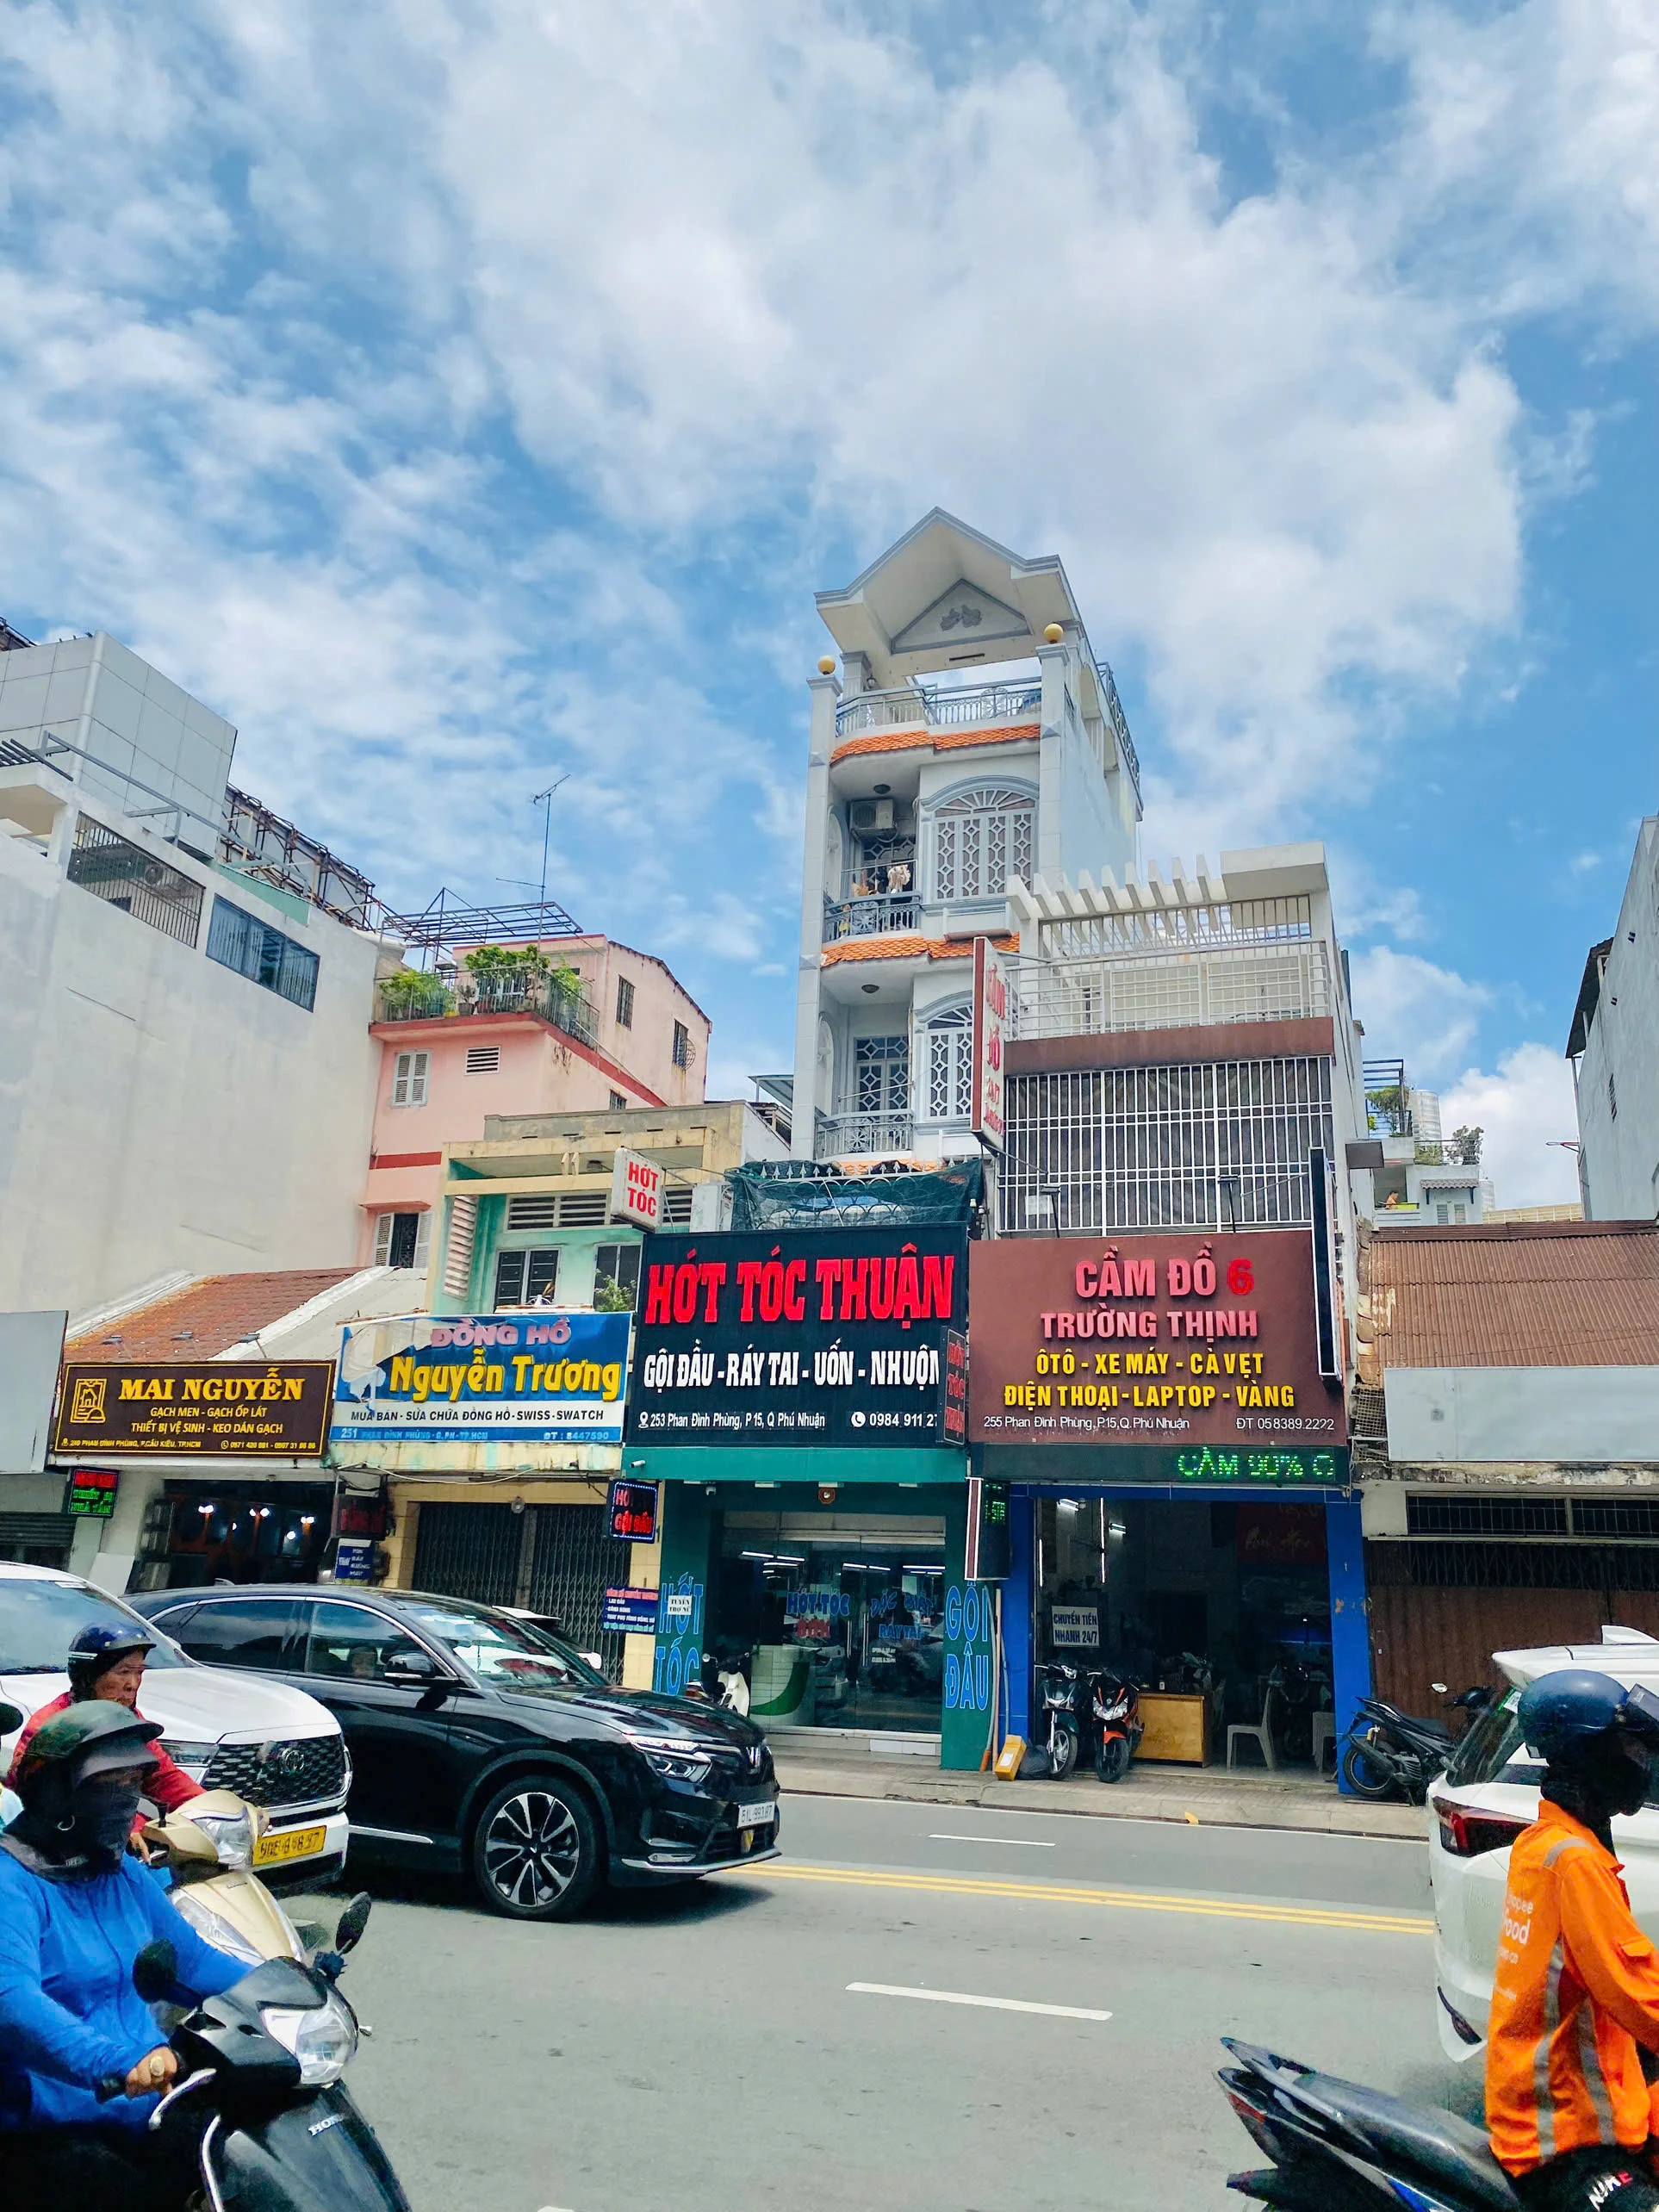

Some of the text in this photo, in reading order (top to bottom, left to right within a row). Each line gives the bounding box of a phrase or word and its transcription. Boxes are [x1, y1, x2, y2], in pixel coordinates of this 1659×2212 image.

[628, 1161, 658, 1192] HỚT
[627, 1186, 656, 1216] TÓC
[1075, 1241, 1254, 1297] CẦM ĐỒ 6
[644, 1242, 954, 1329] HỚT TÓC THUẬN
[430, 1316, 572, 1348] ĐỒNG HỒ
[1041, 1302, 1258, 1343] TRƯỜNG THỊNH
[389, 1347, 622, 1403] Nguyễn Trương
[643, 1347, 675, 1393] GỘI
[676, 1339, 714, 1388] ĐẦU
[727, 1343, 764, 1387] RÁY
[768, 1351, 799, 1386] TAI
[813, 1337, 854, 1386] UỐN
[1036, 1346, 1264, 1378] ÔTÔ XE MÁY CÀ VẸT
[118, 1367, 306, 1401] MAI NGUYỄN
[1004, 1380, 1295, 1411] ĐIỆN THOẠI LAPTOP VÀNG
[150, 1404, 268, 1420] GẠCH MEN GẠCH ỐP LÁT
[351, 1411, 374, 1421] MUA
[650, 1413, 666, 1426] 253
[667, 1413, 688, 1427] Phan
[691, 1413, 710, 1427] Đình
[712, 1413, 743, 1430] Phùng,
[777, 1412, 795, 1426] Phú
[798, 1413, 825, 1429] Nhuận
[869, 1413, 899, 1427] 0984
[904, 1413, 923, 1427] 911
[984, 1416, 1002, 1428] 255
[1004, 1416, 1031, 1428] Phan
[1034, 1415, 1057, 1428] Đình
[1156, 1417, 1190, 1430] Nhuận
[1236, 1417, 1254, 1430] ĐT
[131, 1420, 283, 1436] THIẾT BỊ VỆ SINH KEO DÁN GẠCH
[340, 1427, 357, 1438] 251
[1054, 1630, 1080, 1643] NHANH
[656, 1636, 699, 1696] TÓC
